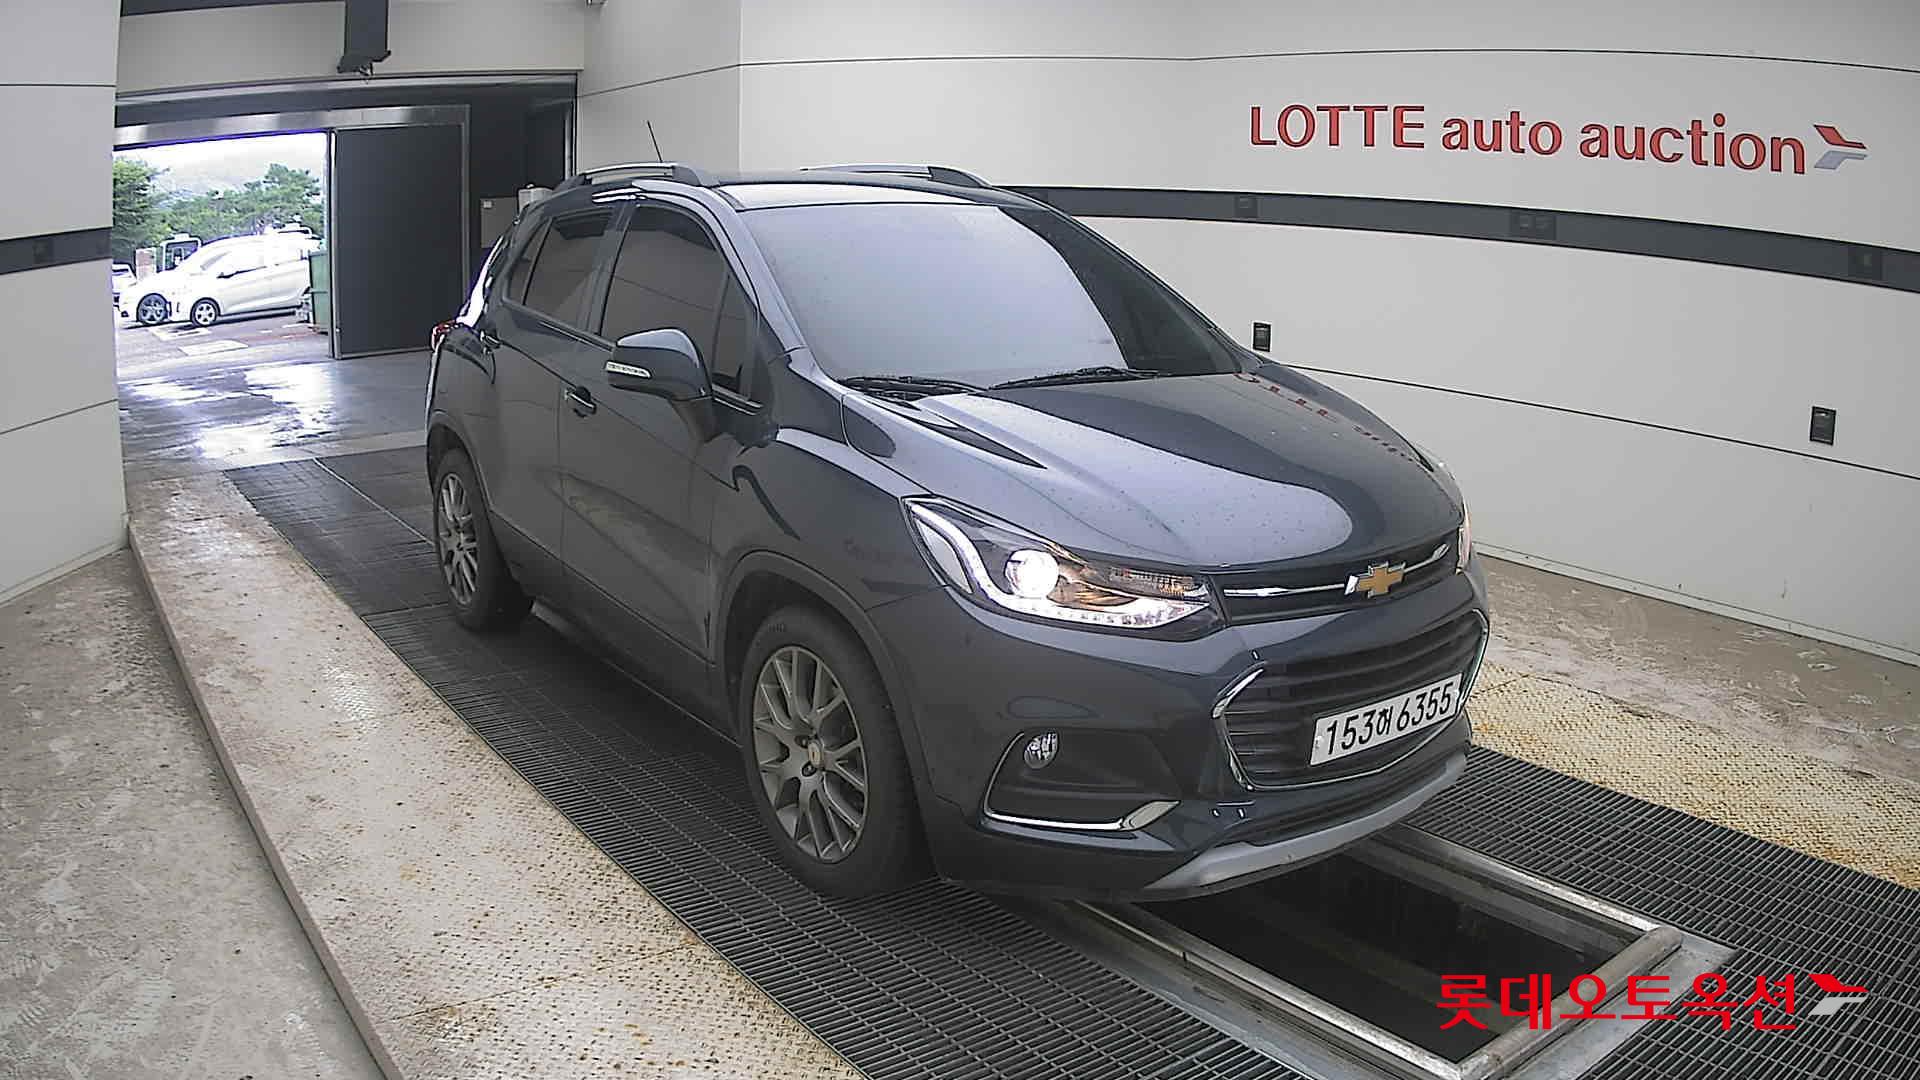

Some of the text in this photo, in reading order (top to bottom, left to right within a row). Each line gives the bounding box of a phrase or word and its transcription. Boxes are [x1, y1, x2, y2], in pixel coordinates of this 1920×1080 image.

[1251, 104, 1806, 174] LOTTE auto auction
